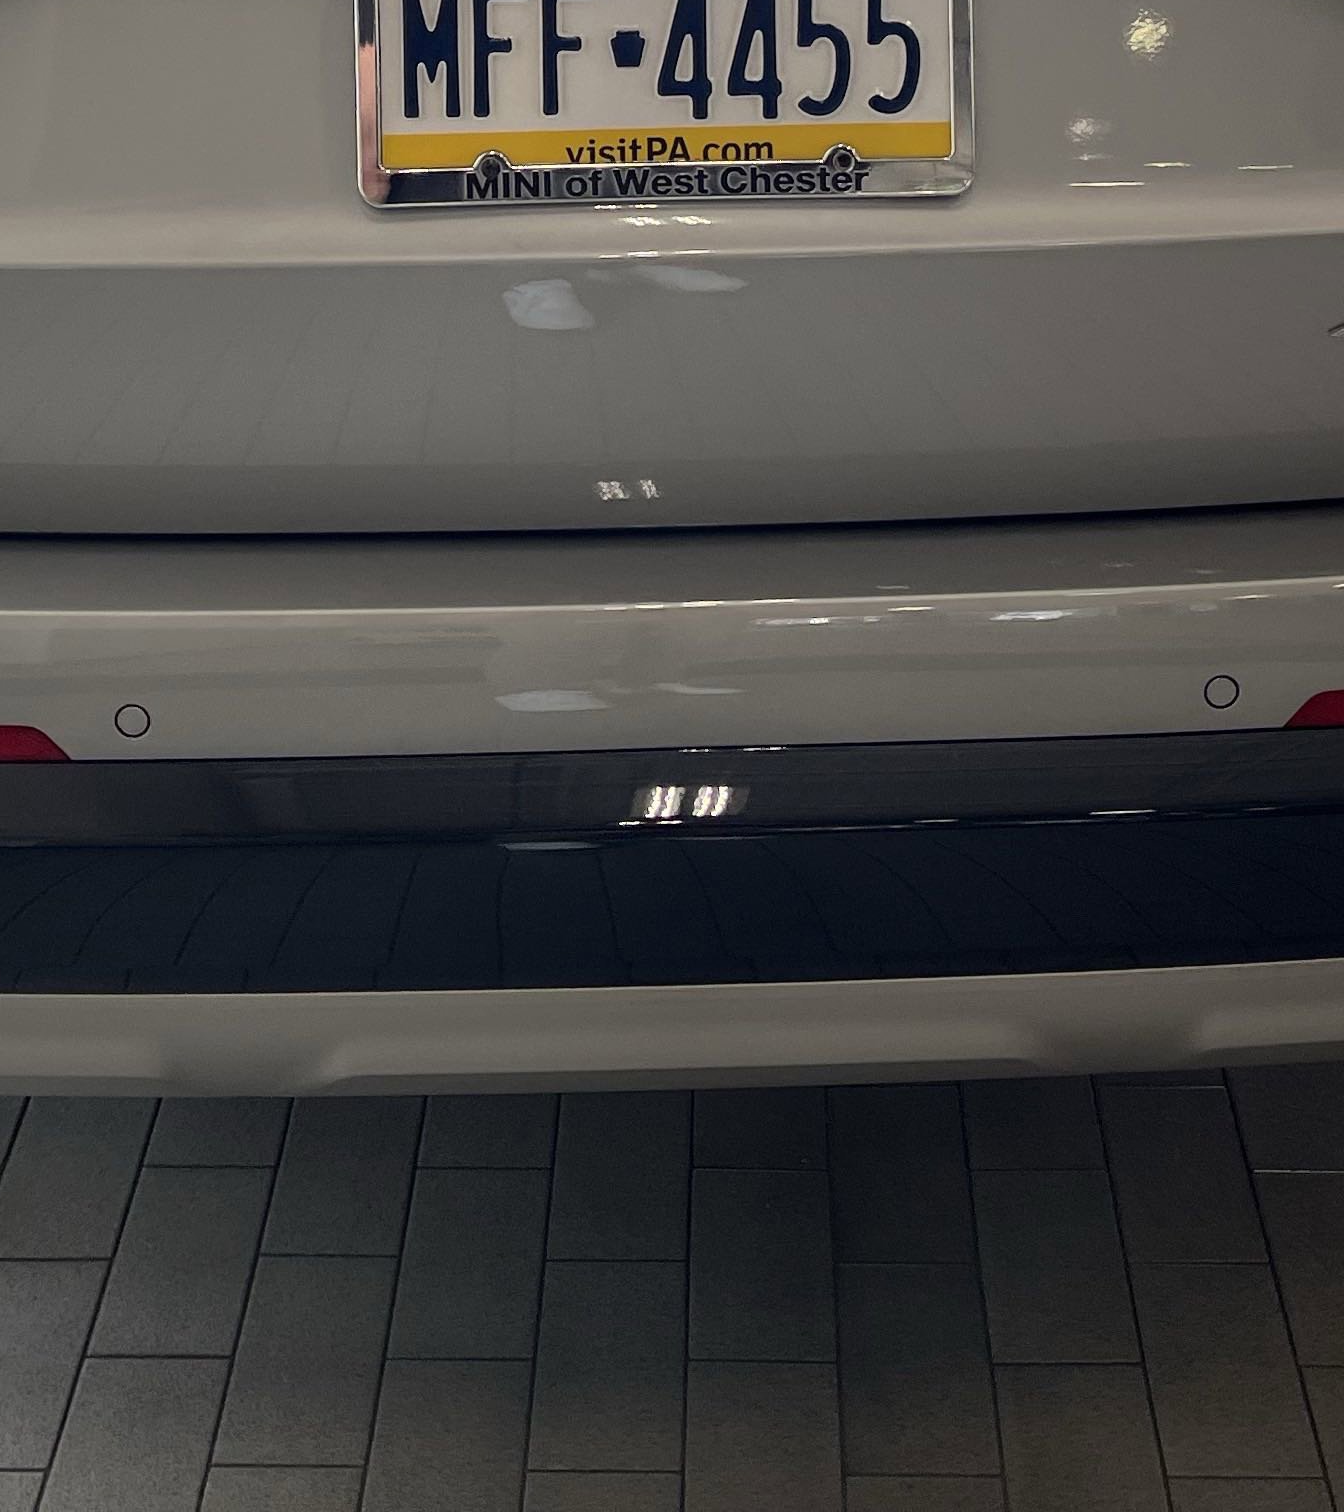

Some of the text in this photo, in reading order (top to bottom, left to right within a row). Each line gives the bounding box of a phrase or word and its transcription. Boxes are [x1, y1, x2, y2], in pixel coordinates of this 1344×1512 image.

[565, 136, 774, 164] visitPAcom
[466, 166, 870, 199] MINI of West Chester
